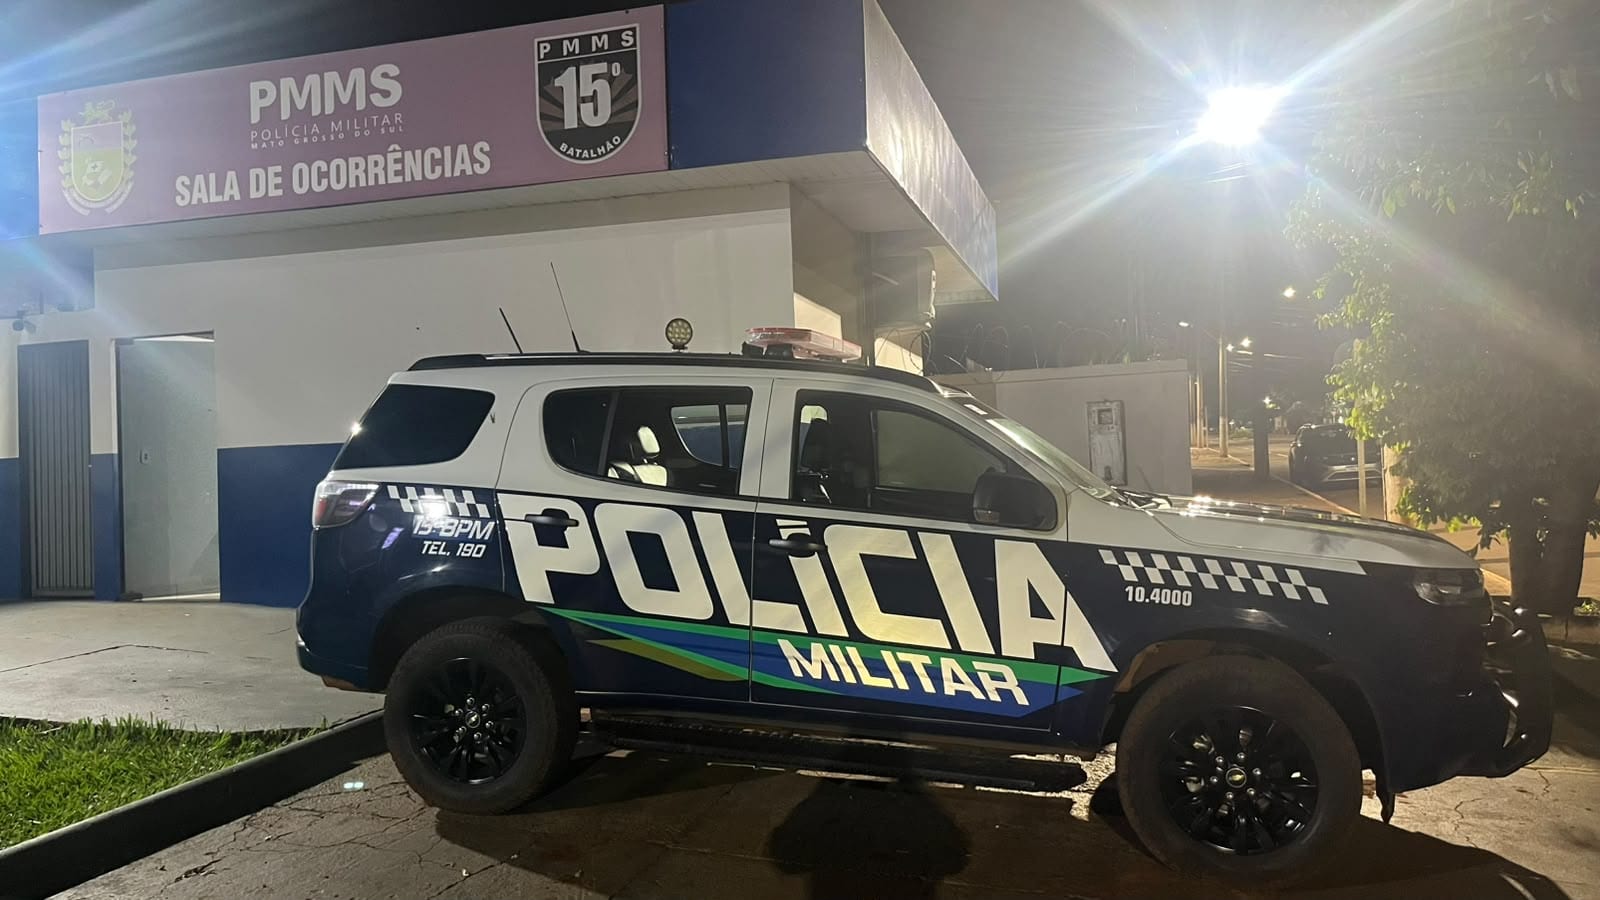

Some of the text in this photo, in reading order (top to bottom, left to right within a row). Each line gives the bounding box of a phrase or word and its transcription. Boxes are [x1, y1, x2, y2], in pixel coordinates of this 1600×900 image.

[540, 30, 634, 59] PMMS
[250, 64, 403, 124] PMMS
[251, 113, 403, 142] POLÍCIA MILITAR
[251, 125, 403, 149] MATO GROSSO DO SUL
[175, 141, 491, 206] SALA DE OCORRÊNCIAS
[456, 543, 486, 558] 190
[497, 493, 1116, 671] POLÍCIA
[1125, 586, 1192, 607] 10.4000
[777, 639, 1030, 707] MILITAR
